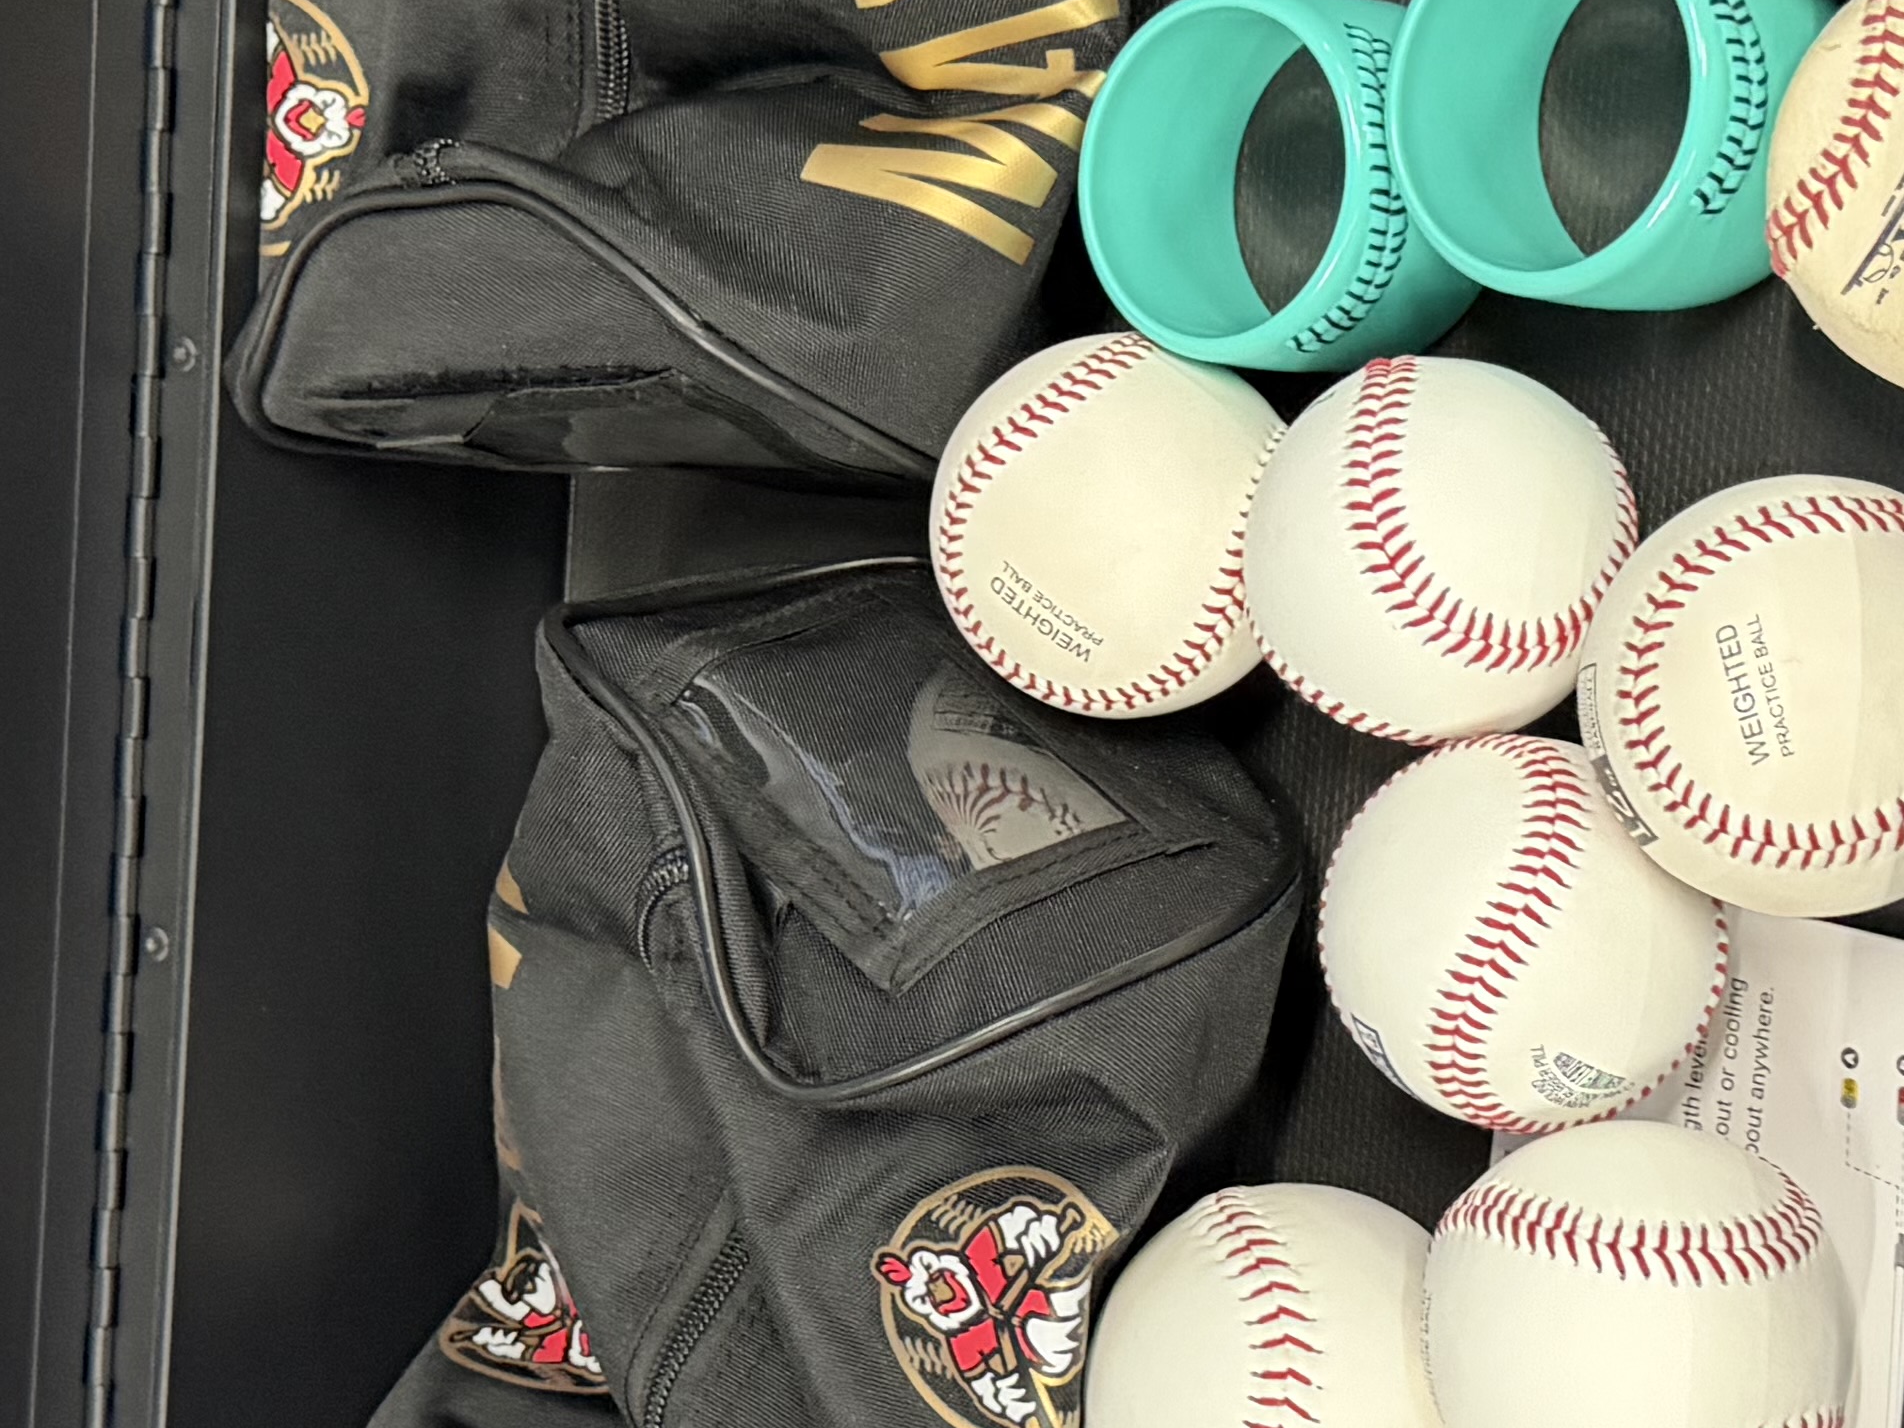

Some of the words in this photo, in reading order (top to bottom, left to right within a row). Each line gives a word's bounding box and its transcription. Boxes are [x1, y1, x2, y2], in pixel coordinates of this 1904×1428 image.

[1002, 559, 1033, 594] BALL
[1032, 589, 1104, 647] PRACTICE
[990, 576, 1091, 663] WEIGHTED
[1747, 614, 1769, 659] BALL
[1715, 624, 1770, 766] WEIGHTED
[1758, 662, 1795, 757] PRACTICE
[1724, 977, 1749, 1060] cooling
[1750, 987, 1776, 1100] anywhere.
[1721, 1066, 1736, 1091] or
